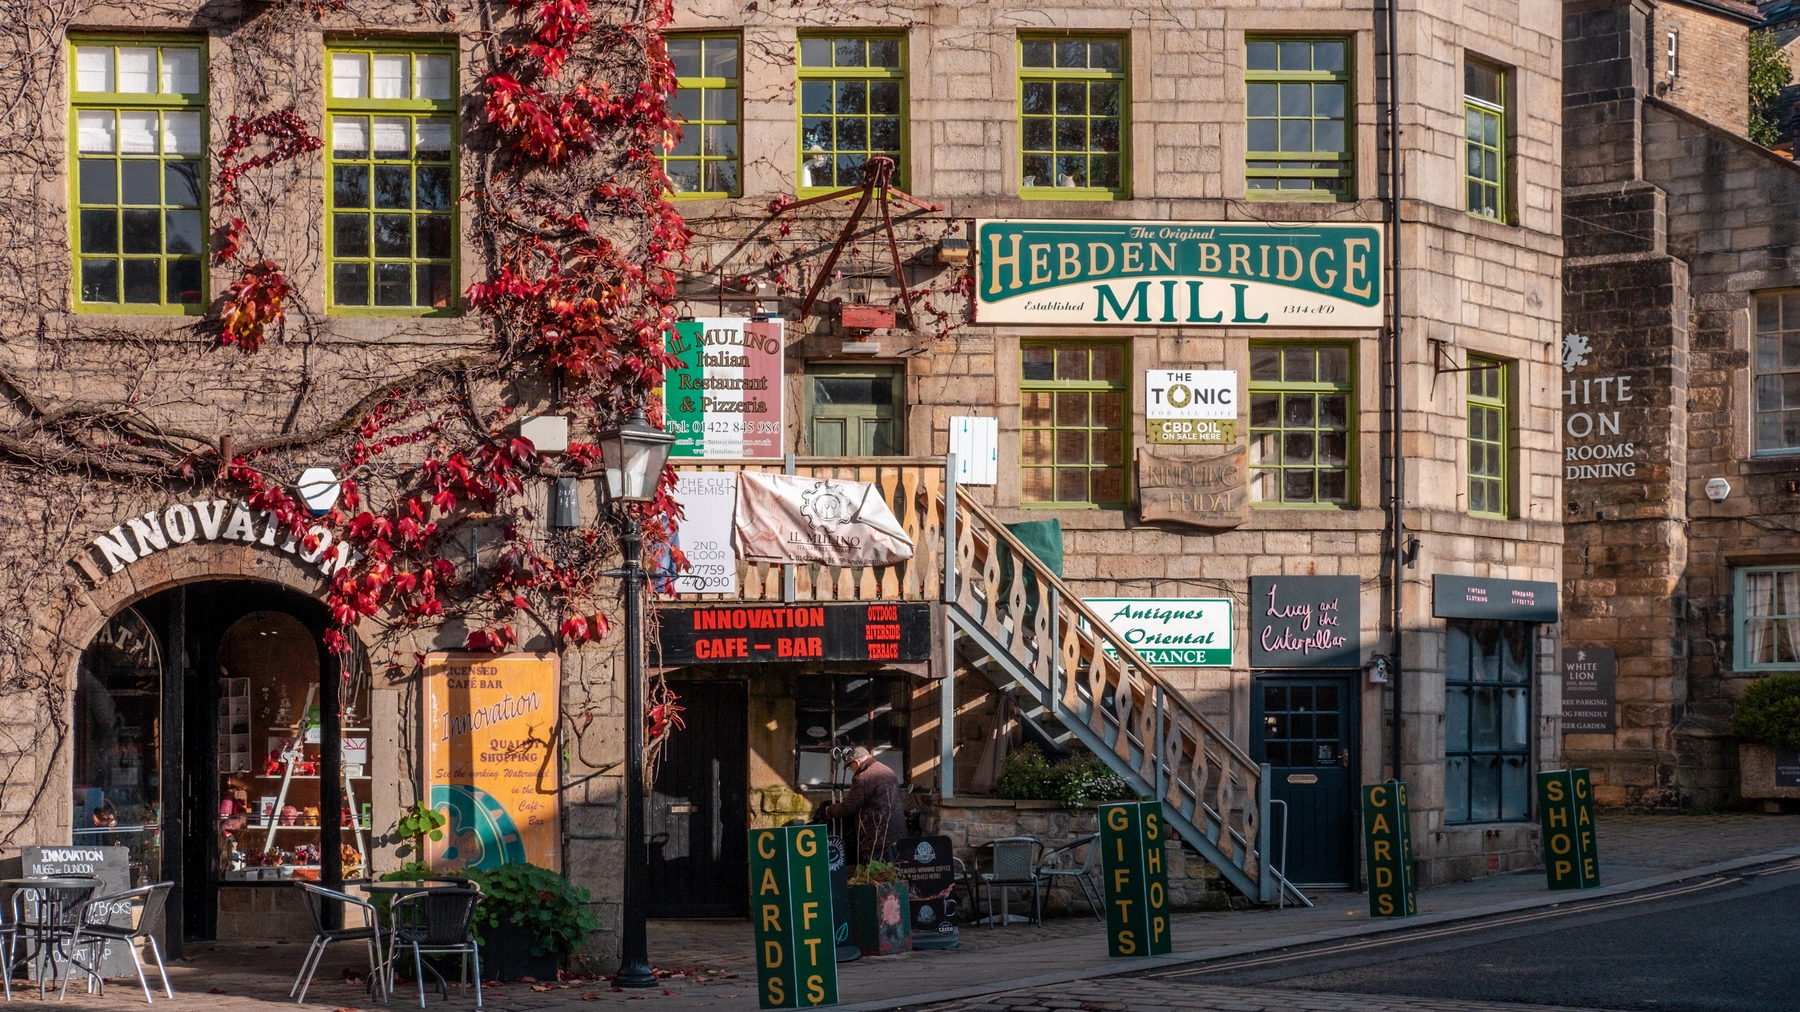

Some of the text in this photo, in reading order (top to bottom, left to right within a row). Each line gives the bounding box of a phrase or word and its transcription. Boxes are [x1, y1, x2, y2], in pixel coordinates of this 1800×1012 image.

[1129, 227, 1215, 241] The Original
[989, 234, 1371, 299] HEBDEN BRIDGE
[1024, 301, 1084, 311] Established
[1093, 280, 1268, 323] MILL
[1283, 305, 1309, 313] 1314
[668, 329, 780, 355] IL MULINO
[697, 351, 750, 367] Italian
[679, 374, 768, 390] Restaurant
[1167, 373, 1192, 381] THE
[1151, 383, 1232, 408] TONIC
[1562, 375, 1633, 404] HITE
[679, 396, 767, 413] & Pizzeria
[668, 421, 780, 434] Tel: 01422 845 986
[1162, 422, 1221, 433] CBD OIL
[1567, 411, 1620, 438] ON
[1565, 443, 1634, 461] ROOMS
[1148, 466, 1238, 487] KINDLING
[1565, 462, 1636, 480] DINING
[681, 478, 731, 486] THE CUT
[681, 487, 730, 495] CHEMIST
[1168, 492, 1237, 512] BRIDAL
[790, 532, 801, 541] IL
[694, 541, 717, 550] 2ND
[687, 551, 725, 560] FLOOR
[688, 565, 724, 575] 07759
[1267, 584, 1338, 631] Lucy and
[1511, 598, 1535, 606] LIFESTYLE
[694, 608, 824, 630] INNOVATION
[868, 606, 897, 621] OUTDOOR
[1110, 604, 1203, 625] Antiques
[1319, 612, 1339, 627] the
[866, 625, 900, 640] RIVERSIDE
[1124, 628, 1215, 645] Oriental
[1261, 626, 1346, 654] Caterpillar
[696, 638, 748, 659] CAFE
[777, 637, 822, 658] BAR
[868, 643, 898, 658] TERRACE
[1110, 651, 1206, 663] ETRANCE
[442, 666, 497, 675] LICENSED
[1566, 663, 1598, 671] WHITE
[1570, 672, 1594, 680] LION
[480, 680, 503, 689] BAR
[441, 691, 542, 742] Innovation
[490, 739, 540, 750] QUALITY
[480, 753, 538, 762] SHOPPING
[436, 768, 550, 779] See the working Waterwheel
[522, 785, 534, 794] the
[528, 816, 544, 825] Bar
[1547, 780, 1573, 881] SHOP
[1576, 778, 1595, 879] CAFE
[41, 849, 103, 862] INNOVATION
[1370, 786, 1394, 915] CARDS
[1400, 785, 1414, 913] GIFTS
[33, 864, 54, 874] MUGS
[1107, 807, 1136, 955] GIFTS
[1146, 813, 1165, 943] SHOP
[757, 831, 785, 1005] CARDS
[796, 829, 825, 1003] GIFTS
